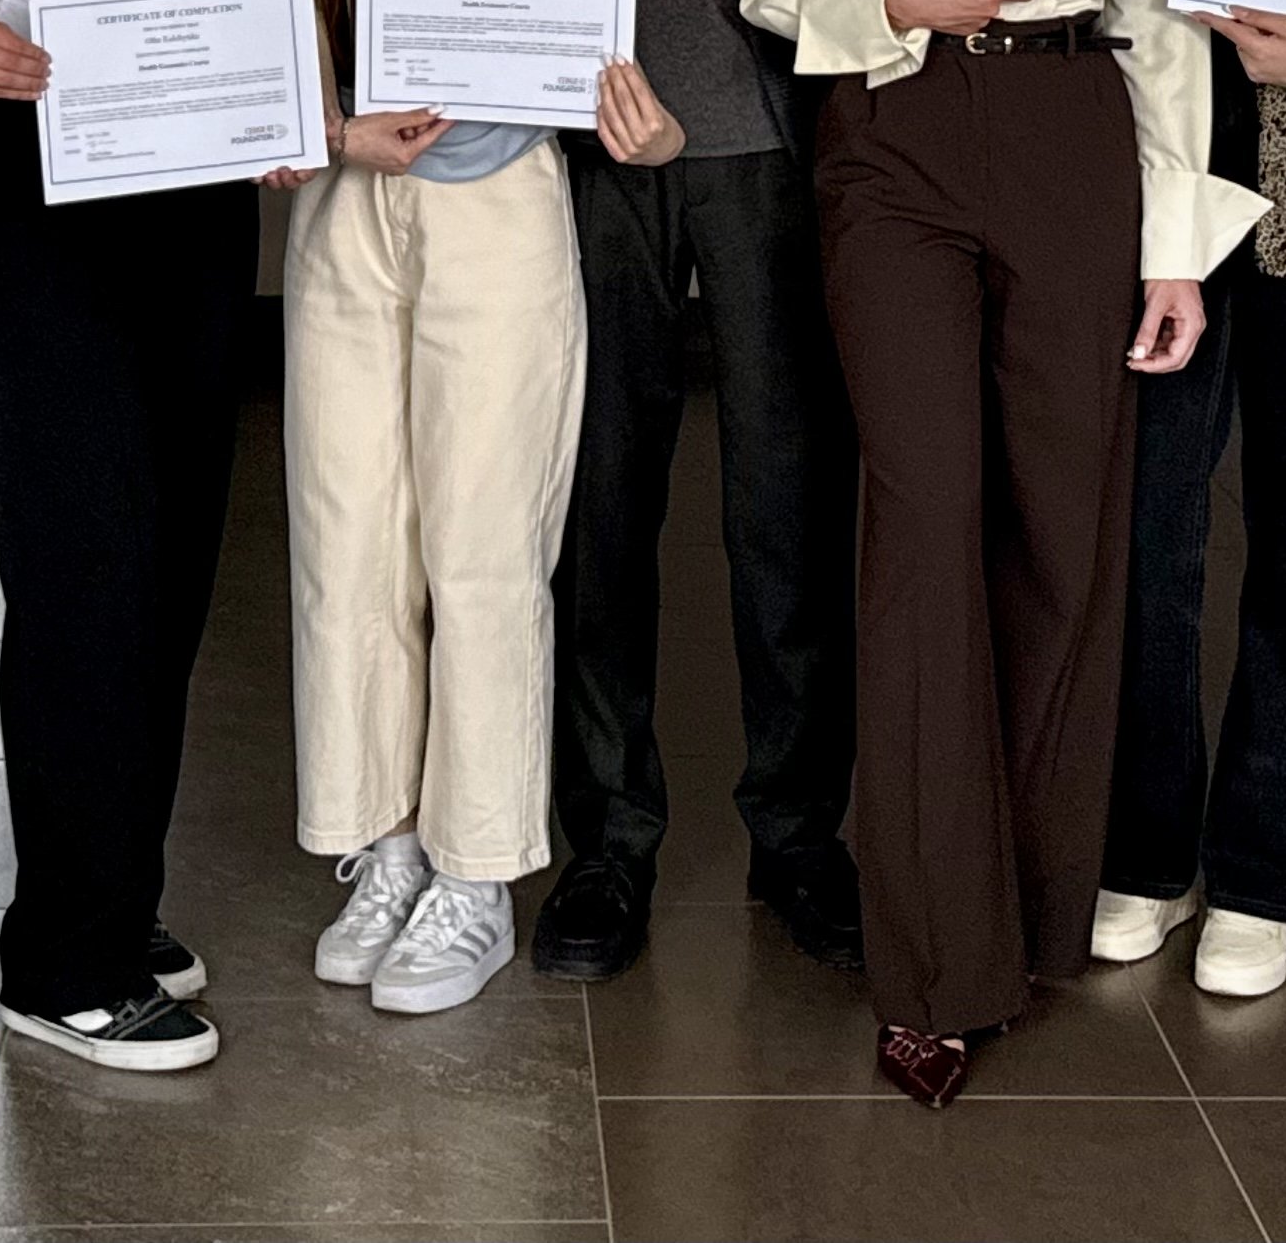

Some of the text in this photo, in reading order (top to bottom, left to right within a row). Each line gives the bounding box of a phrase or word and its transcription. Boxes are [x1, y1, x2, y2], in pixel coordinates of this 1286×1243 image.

[97, 2, 242, 25] CERTIFICATE OF COMPLETION
[542, 84, 585, 93] FOUNDATION
[230, 132, 274, 145] FOUNDATION
